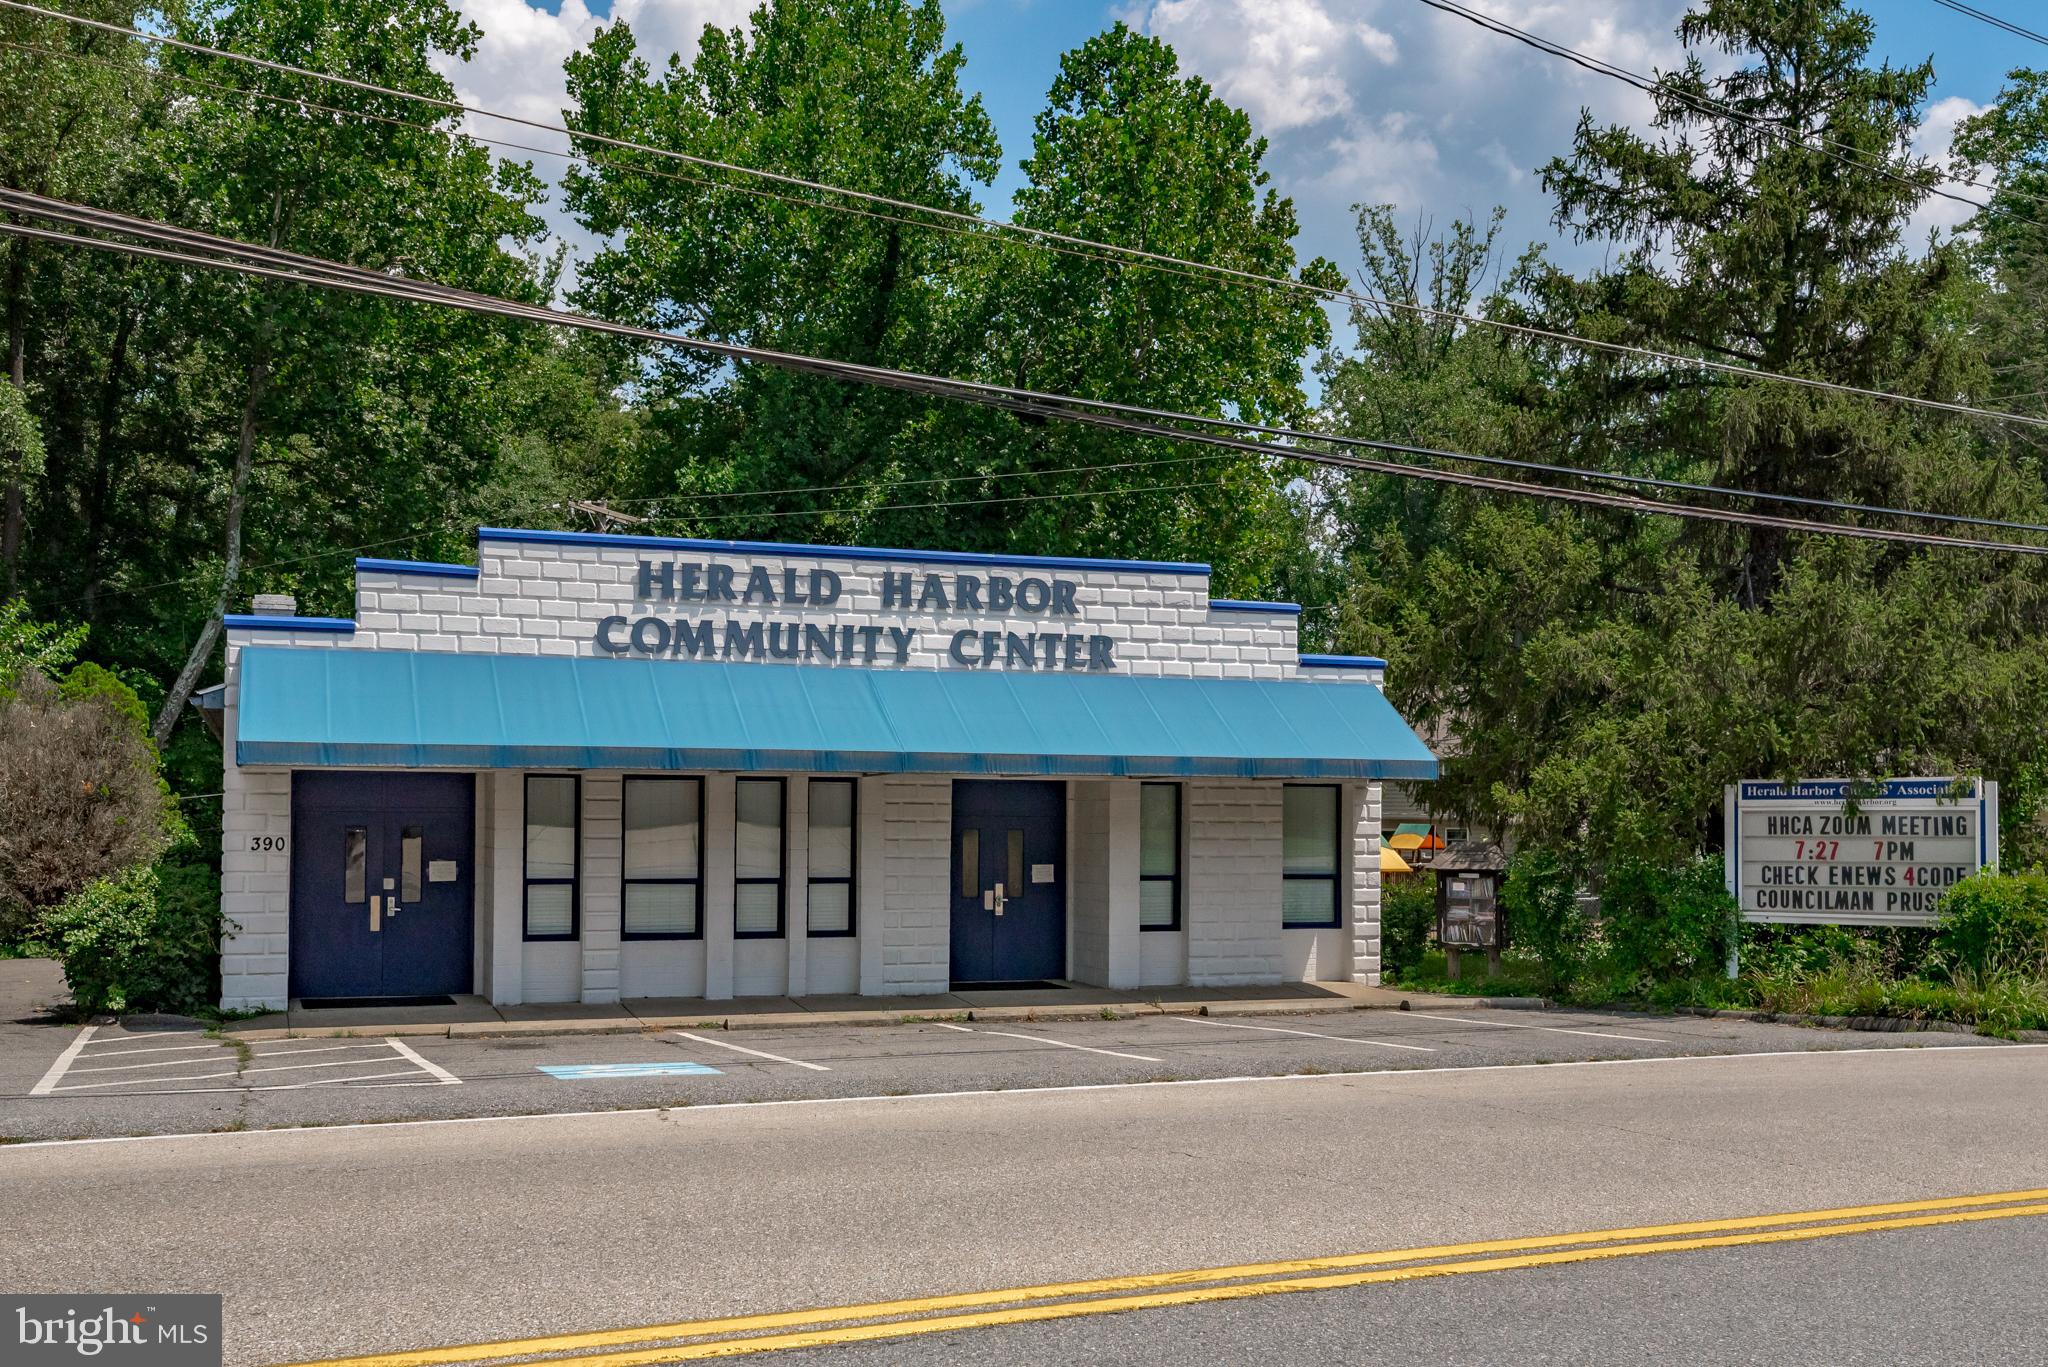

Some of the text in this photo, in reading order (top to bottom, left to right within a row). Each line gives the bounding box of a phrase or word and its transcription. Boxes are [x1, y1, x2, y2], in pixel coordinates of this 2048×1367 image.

[638, 560, 1080, 615] HERALD HARBOR
[597, 615, 916, 663] COMMUNITY
[1791, 785, 1836, 796] Harbor
[1767, 815, 1967, 836] HHCA ZOOM MEETING
[251, 837, 285, 851] 390
[1795, 841, 1839, 860] 7:27
[1761, 865, 1819, 885] CHECK
[1829, 866, 1896, 885] ENEWS
[1757, 889, 1874, 910] COUNCILMAN
